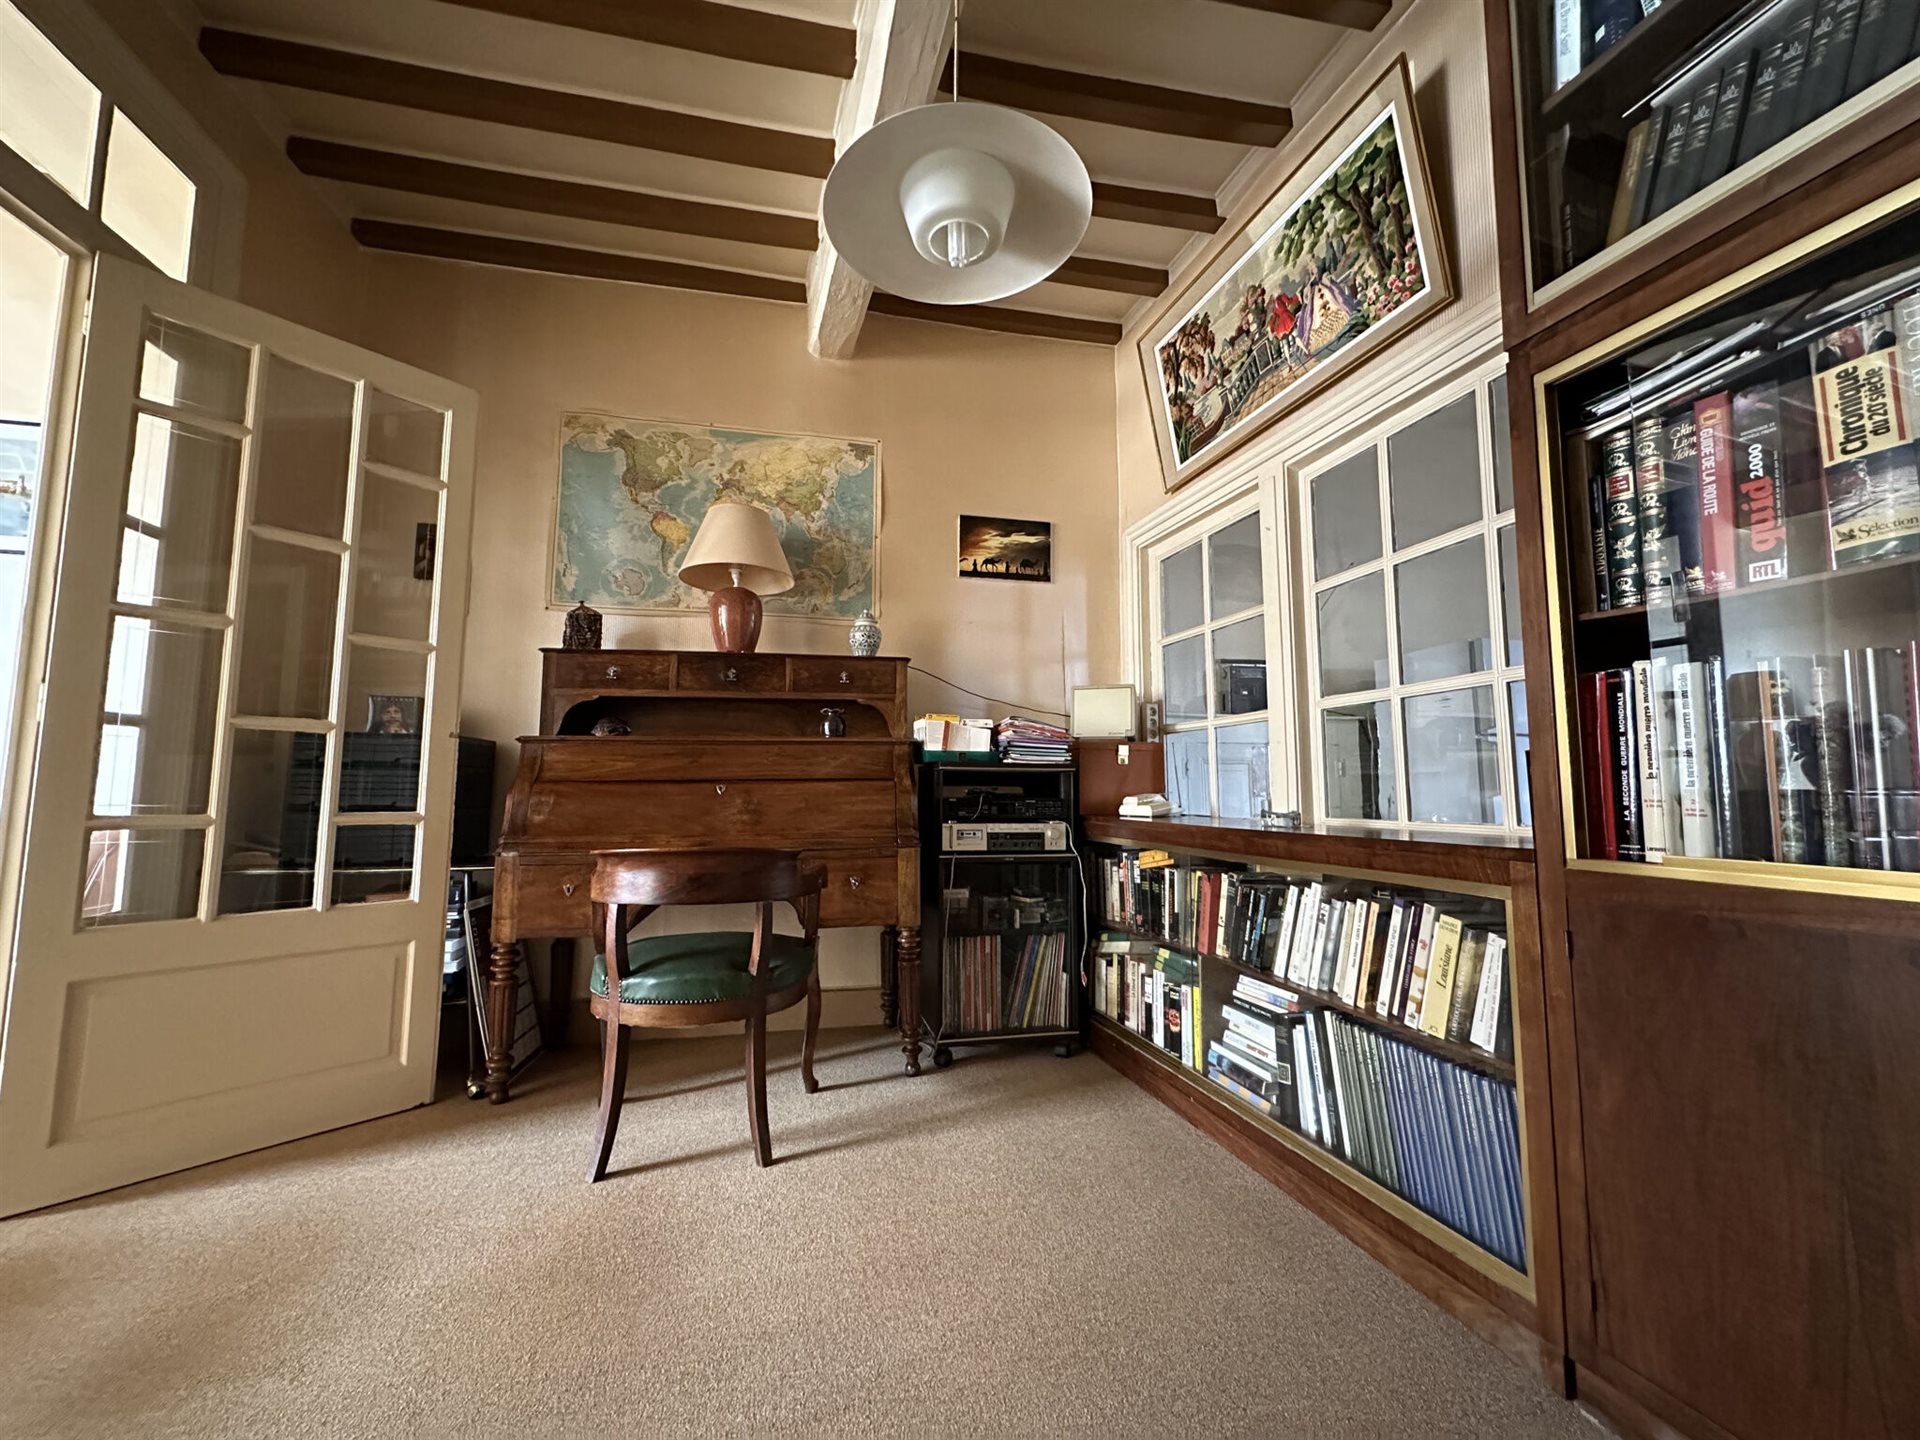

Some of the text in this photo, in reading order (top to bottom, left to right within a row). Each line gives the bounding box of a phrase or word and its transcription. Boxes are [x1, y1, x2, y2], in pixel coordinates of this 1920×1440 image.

[1834, 366, 1868, 455] Chronique
[1869, 418, 1890, 436] du
[1700, 427, 1718, 516] GUIDE DE LA ROUTE
[1748, 443, 1764, 479] 2000
[1740, 475, 1786, 552] quid
[1752, 561, 1779, 579] RTL
[1617, 692, 1630, 821] LA SECONDE GUERRE MONDIALE
[1435, 944, 1453, 989] Louisiane
